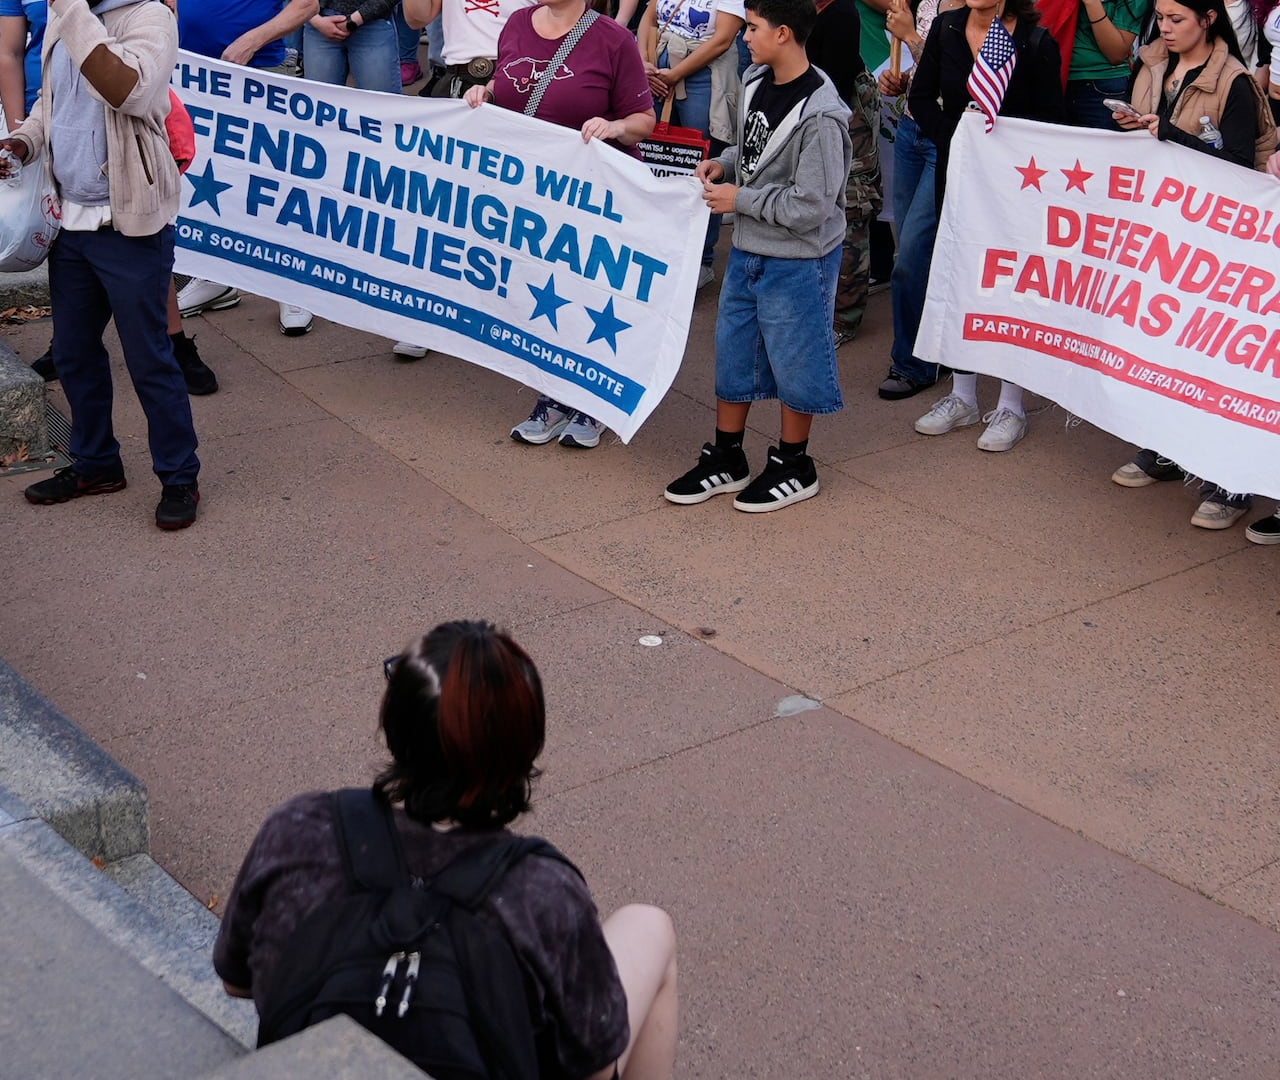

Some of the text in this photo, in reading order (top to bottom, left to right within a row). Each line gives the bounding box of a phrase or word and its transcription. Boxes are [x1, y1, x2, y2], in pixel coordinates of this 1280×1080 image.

[243, 76, 624, 224] PEOPLE UNITED WILL
[1107, 165, 1146, 203] EL
[246, 174, 513, 299] FAMILIES!
[342, 150, 669, 303] IMMIGRANT
[209, 231, 625, 399] SOCIALISM AND LIBERATION @PSLCHARLOTTE
[981, 248, 1182, 338] FAMILIAS
[972, 318, 1030, 340] PARTY
[1034, 331, 1062, 348] FOR
[1099, 349, 1126, 370] AND
[1128, 363, 1206, 403] LIBERATION
